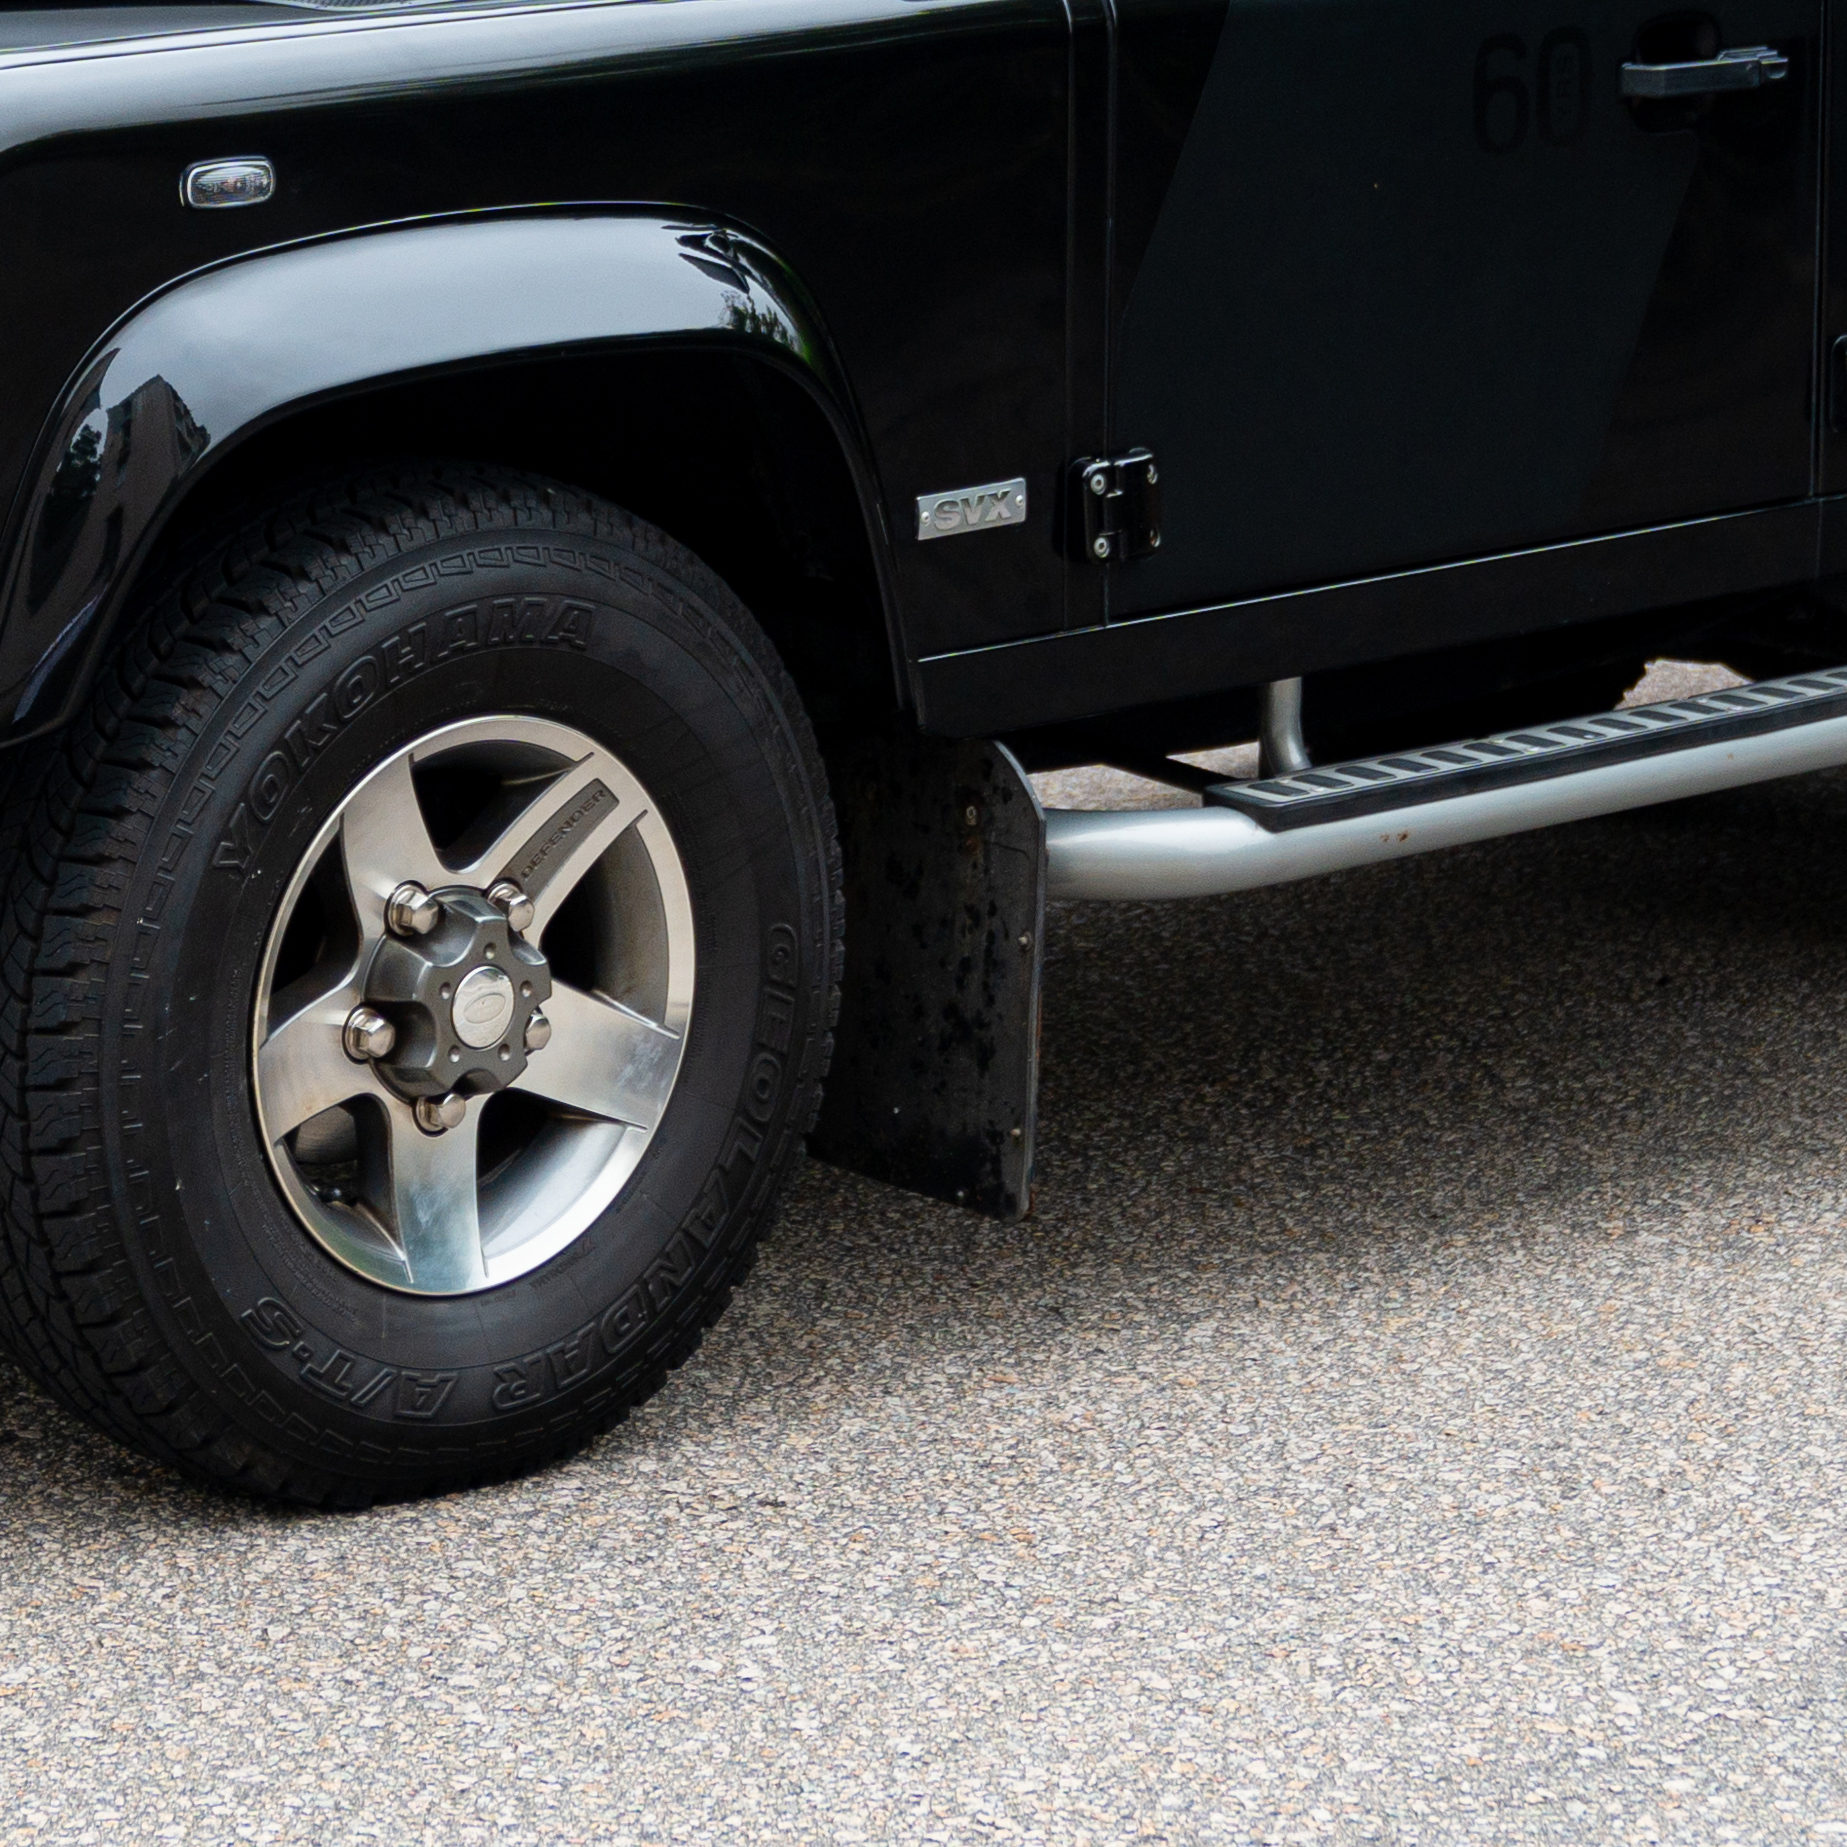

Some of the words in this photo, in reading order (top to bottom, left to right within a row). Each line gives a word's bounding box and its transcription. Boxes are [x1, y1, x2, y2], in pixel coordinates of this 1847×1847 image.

[1472, 25, 1593, 154] 60
[934, 488, 1011, 531] SVX
[210, 595, 596, 873] YOKOHAMA
[521, 789, 606, 879] DEFENDER
[492, 921, 798, 1411] GEOLANDAR
